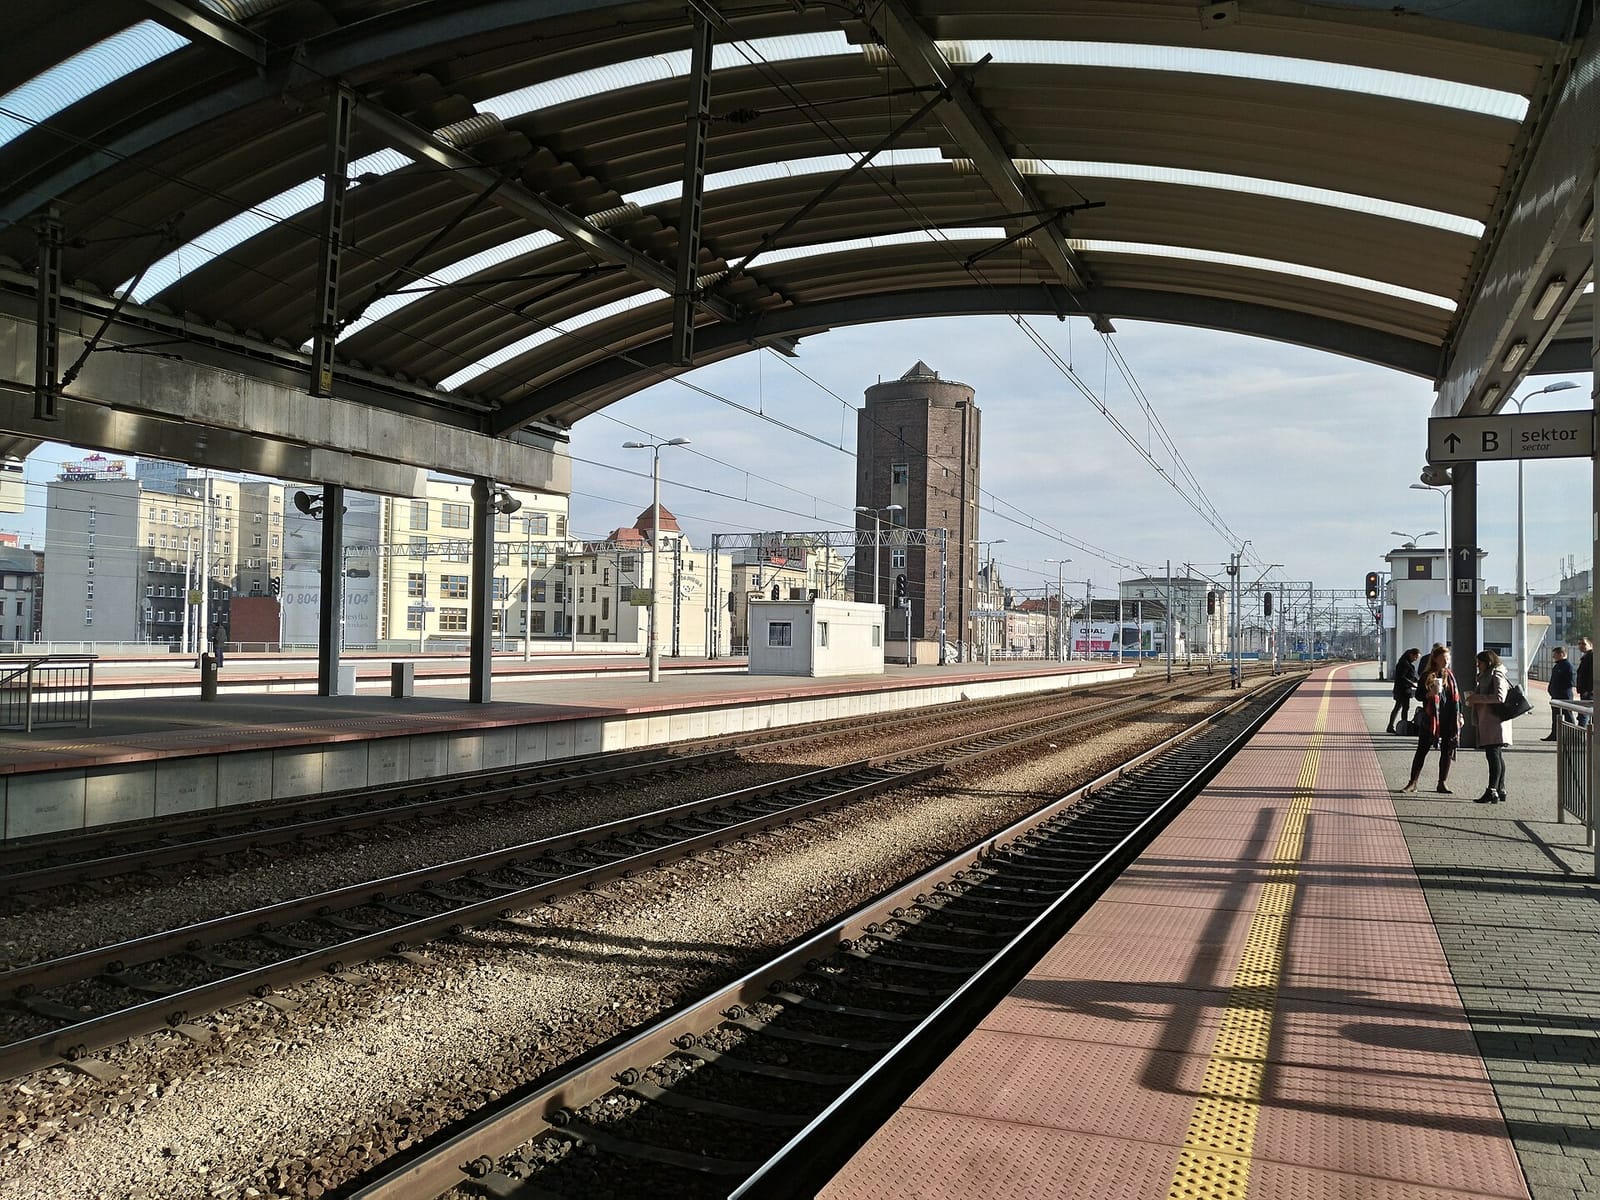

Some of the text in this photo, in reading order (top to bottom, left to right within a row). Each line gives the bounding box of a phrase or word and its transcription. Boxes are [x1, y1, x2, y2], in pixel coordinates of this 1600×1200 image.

[1482, 428, 1578, 452] B sektor
[1521, 443, 1551, 451] sector
[297, 593, 318, 605] 804
[348, 593, 368, 605] 104
